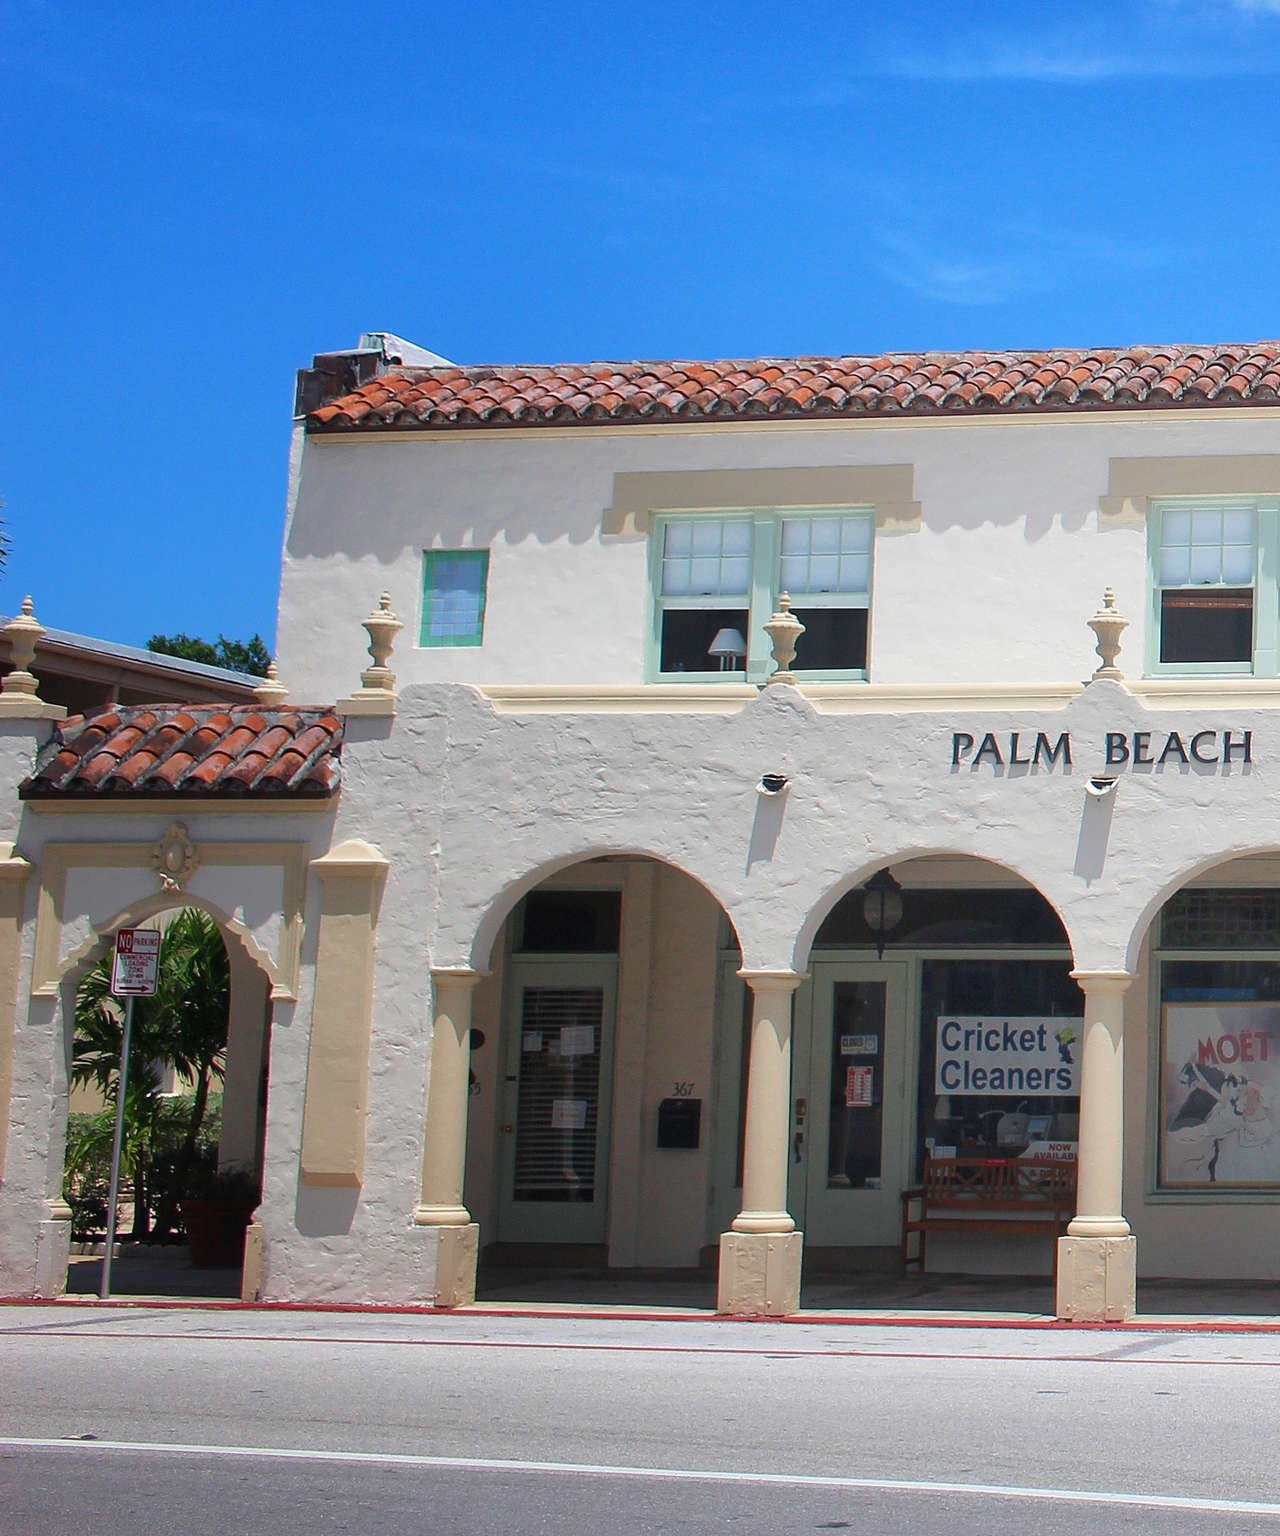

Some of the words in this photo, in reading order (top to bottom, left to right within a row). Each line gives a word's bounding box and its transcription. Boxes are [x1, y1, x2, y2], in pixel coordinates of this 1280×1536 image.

[952, 731, 1072, 765] PALM
[1105, 731, 1252, 765] BEACH
[119, 934, 132, 949] NO
[941, 1021, 1047, 1052] Cricket
[941, 1060, 1072, 1090] Cleaners
[672, 1081, 696, 1096] 367
[1048, 1143, 1072, 1152] NOW
